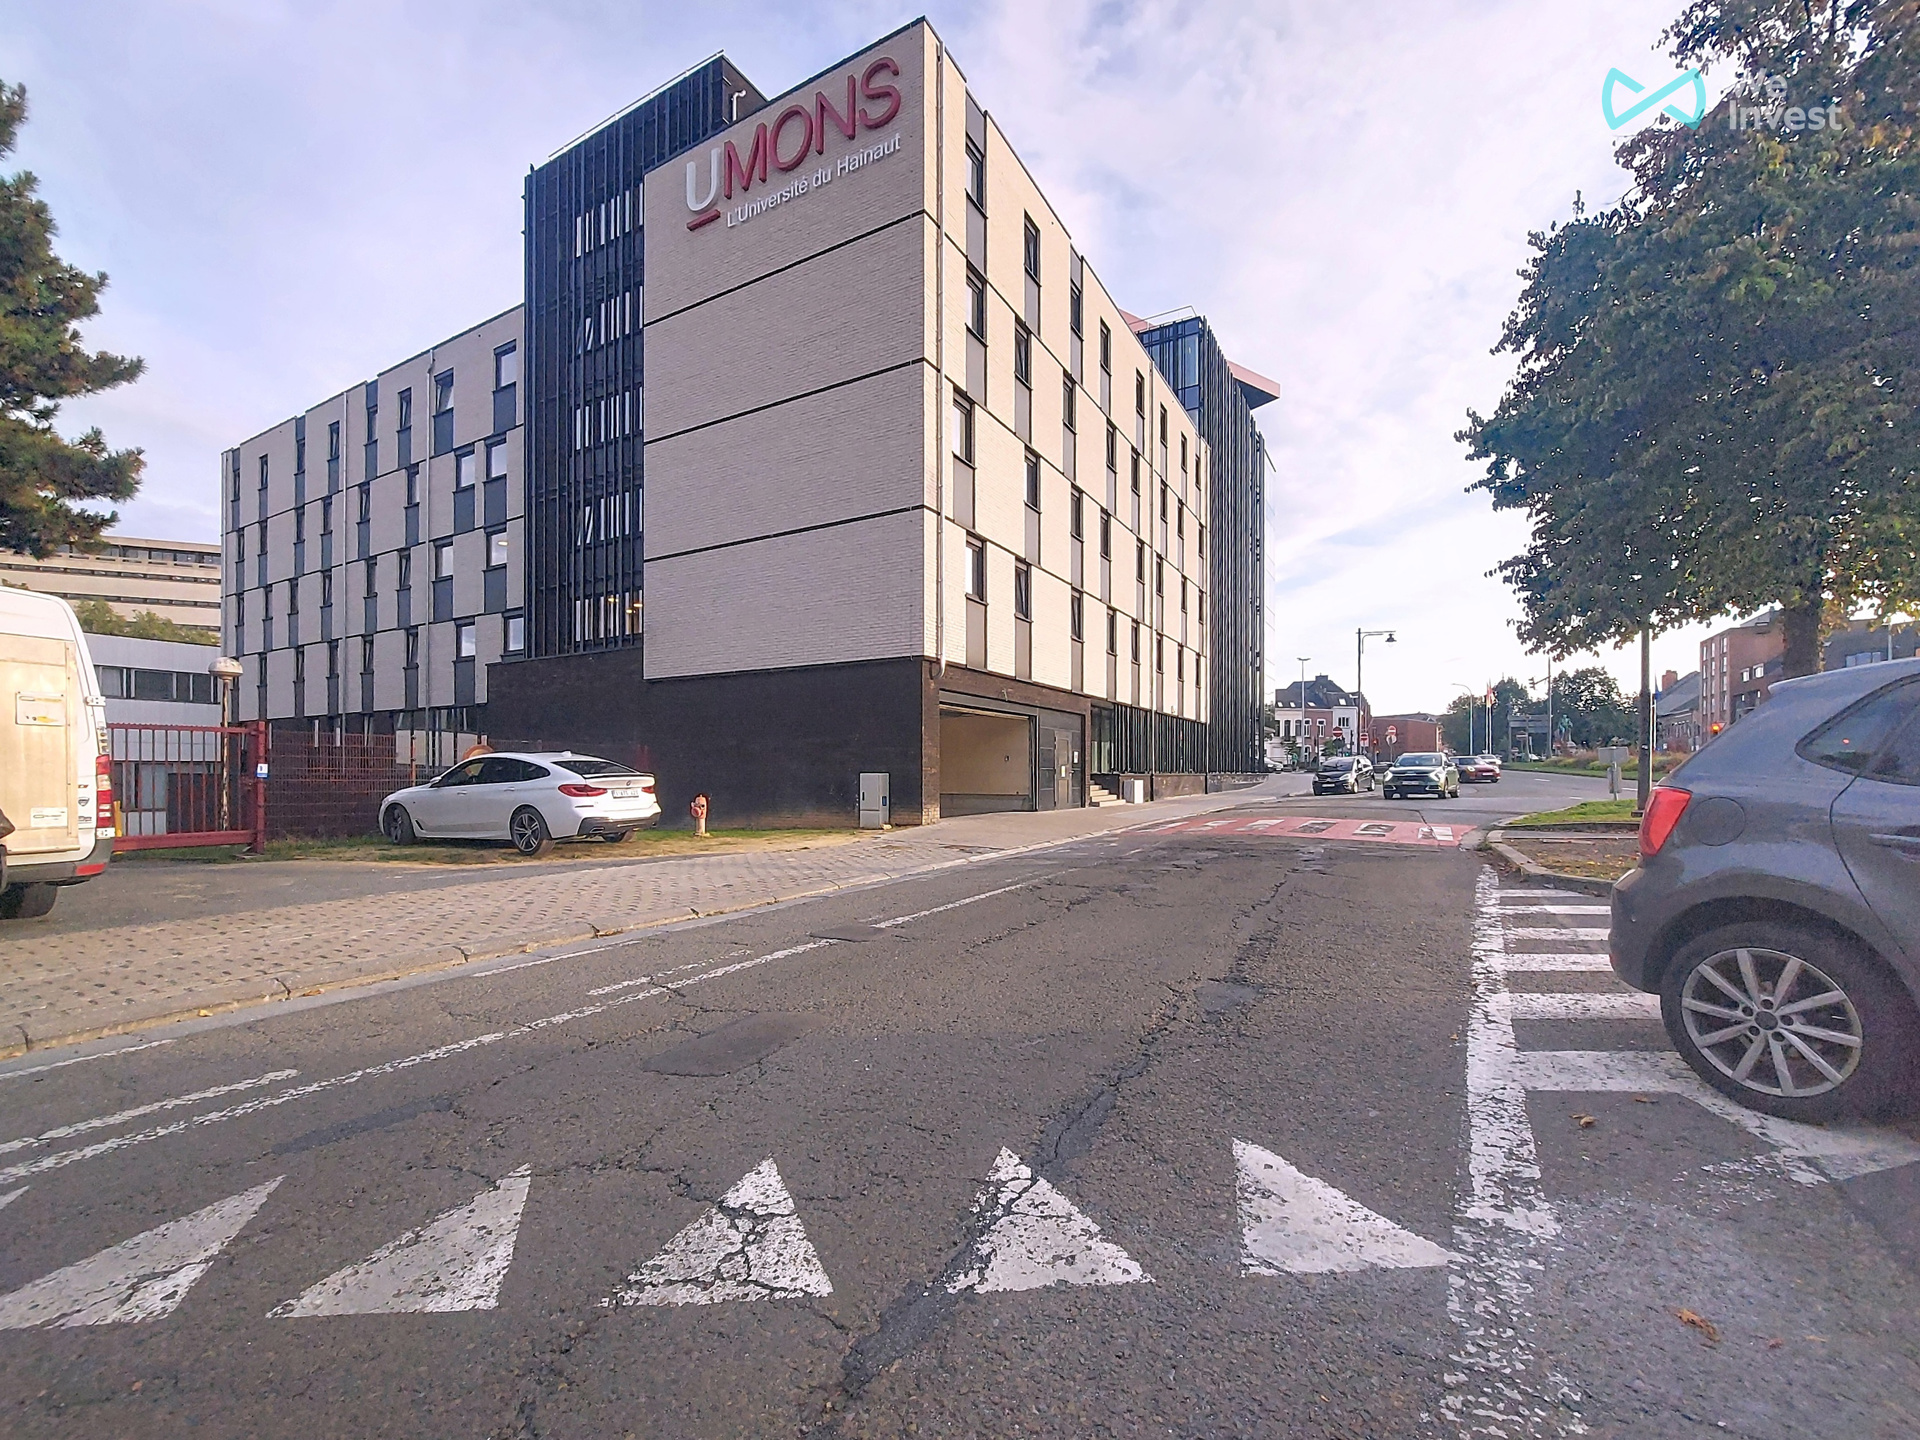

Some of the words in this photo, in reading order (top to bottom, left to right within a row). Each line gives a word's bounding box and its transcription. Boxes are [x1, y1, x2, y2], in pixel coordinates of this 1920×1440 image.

[686, 57, 900, 212] UMONS
[727, 176, 808, 228] L'Université
[813, 166, 832, 187] du
[837, 133, 900, 176] Hainaut
